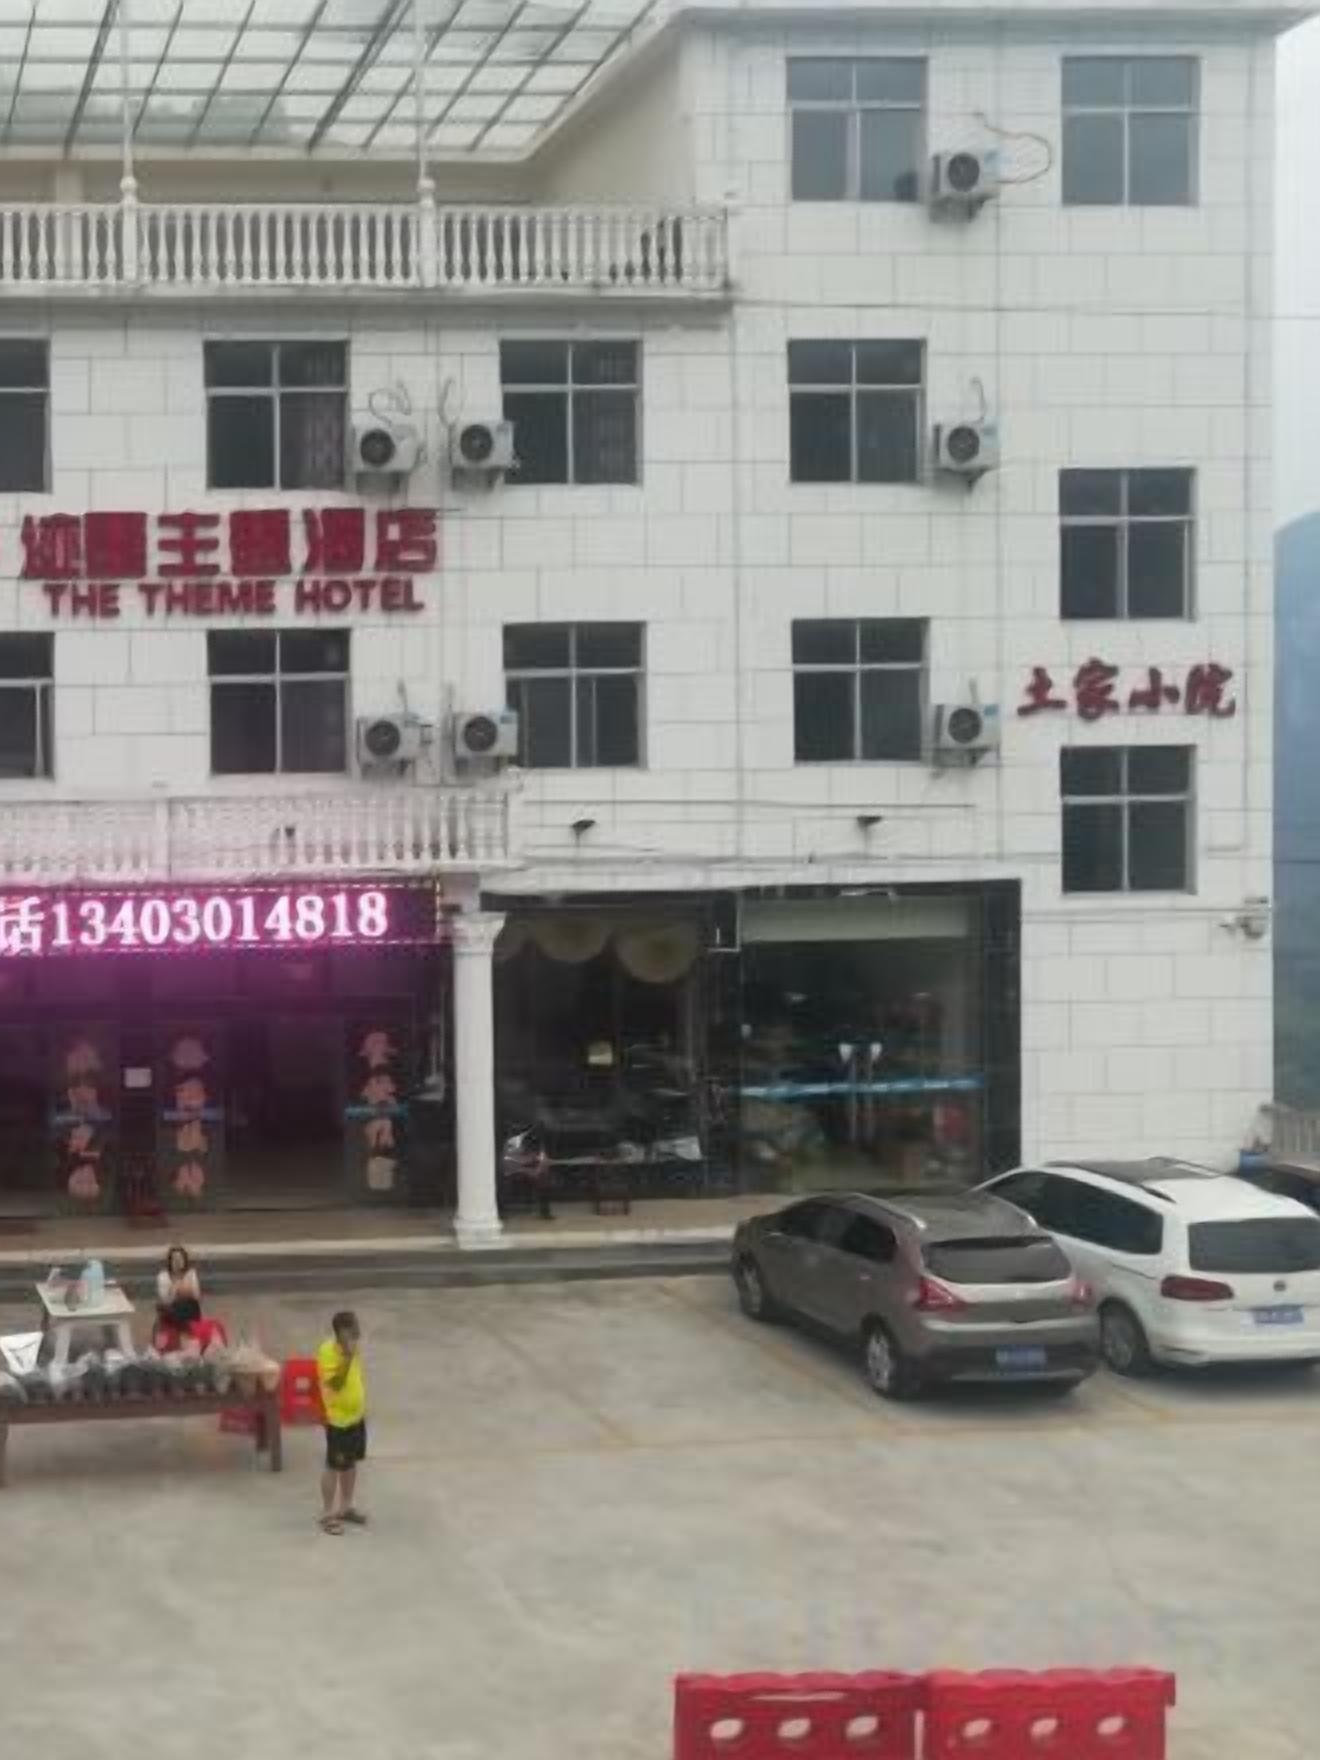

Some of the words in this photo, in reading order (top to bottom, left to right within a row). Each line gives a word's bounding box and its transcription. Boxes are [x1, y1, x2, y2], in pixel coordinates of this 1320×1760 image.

[43, 582, 121, 618] THE
[138, 580, 277, 617] THEME
[294, 577, 425, 615] HOTEL
